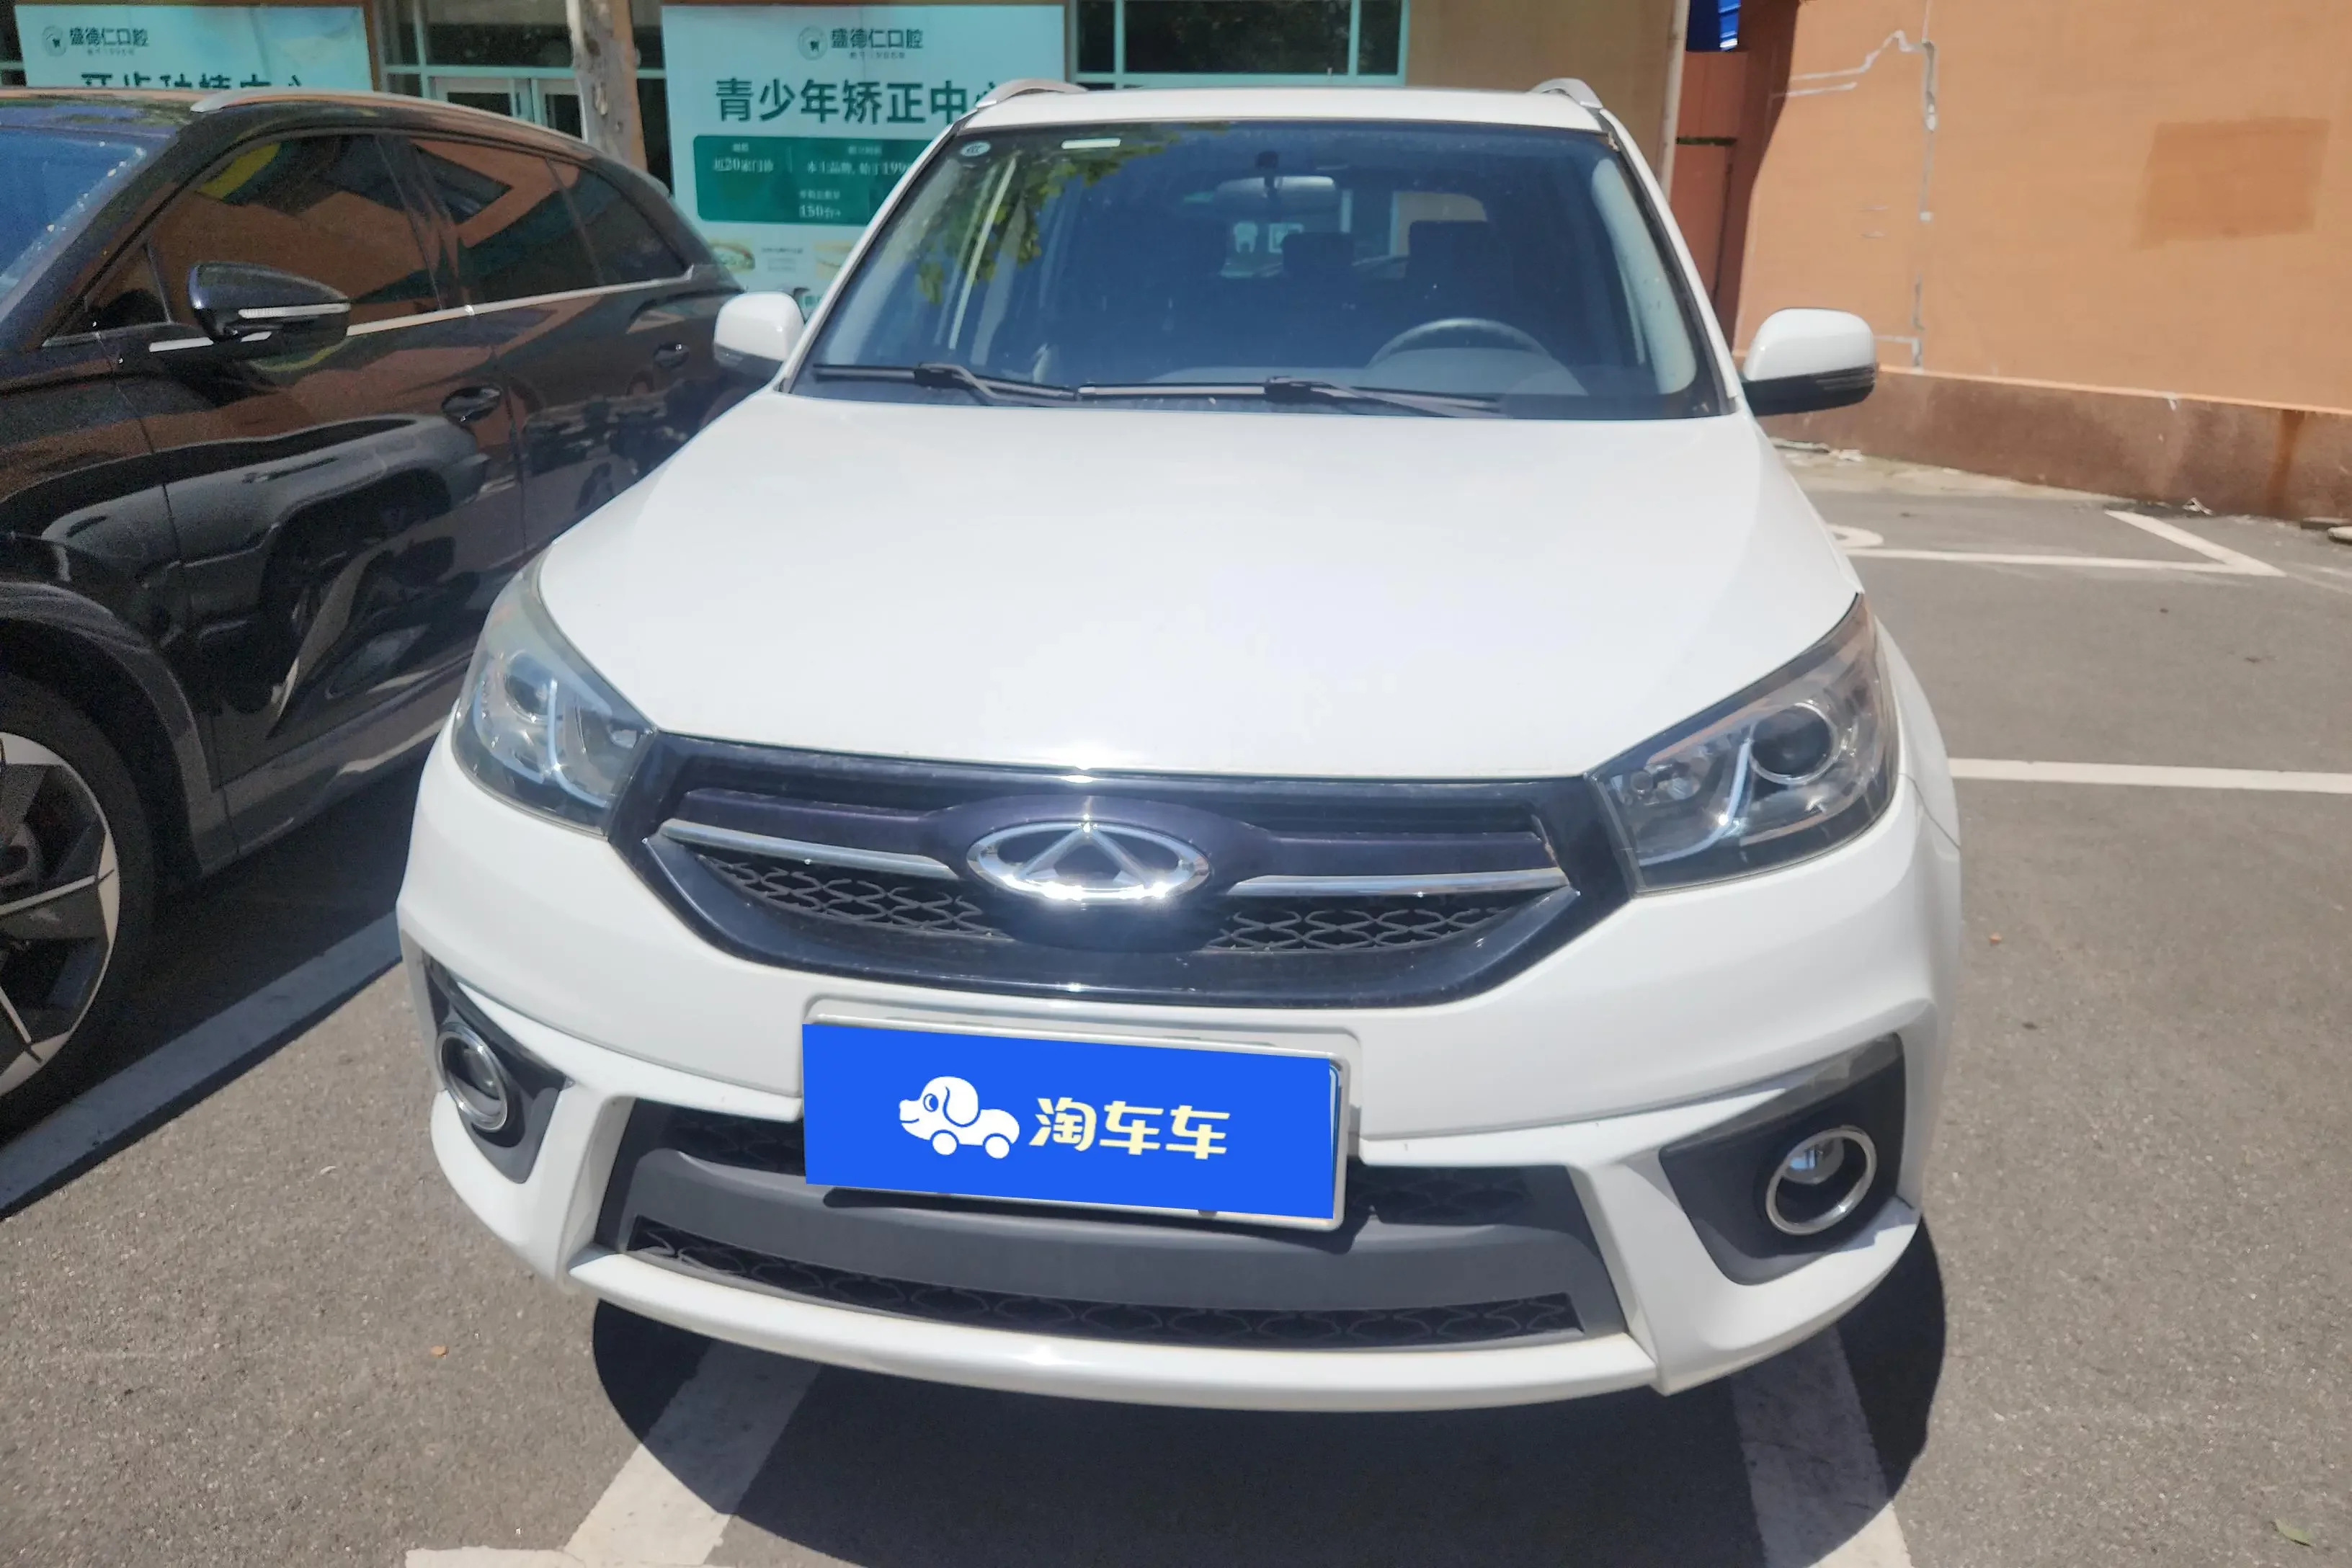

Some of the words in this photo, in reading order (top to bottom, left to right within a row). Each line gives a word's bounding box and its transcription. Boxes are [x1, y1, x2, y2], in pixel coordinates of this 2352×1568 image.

[831, 28, 924, 49] 盛德仁口腔
